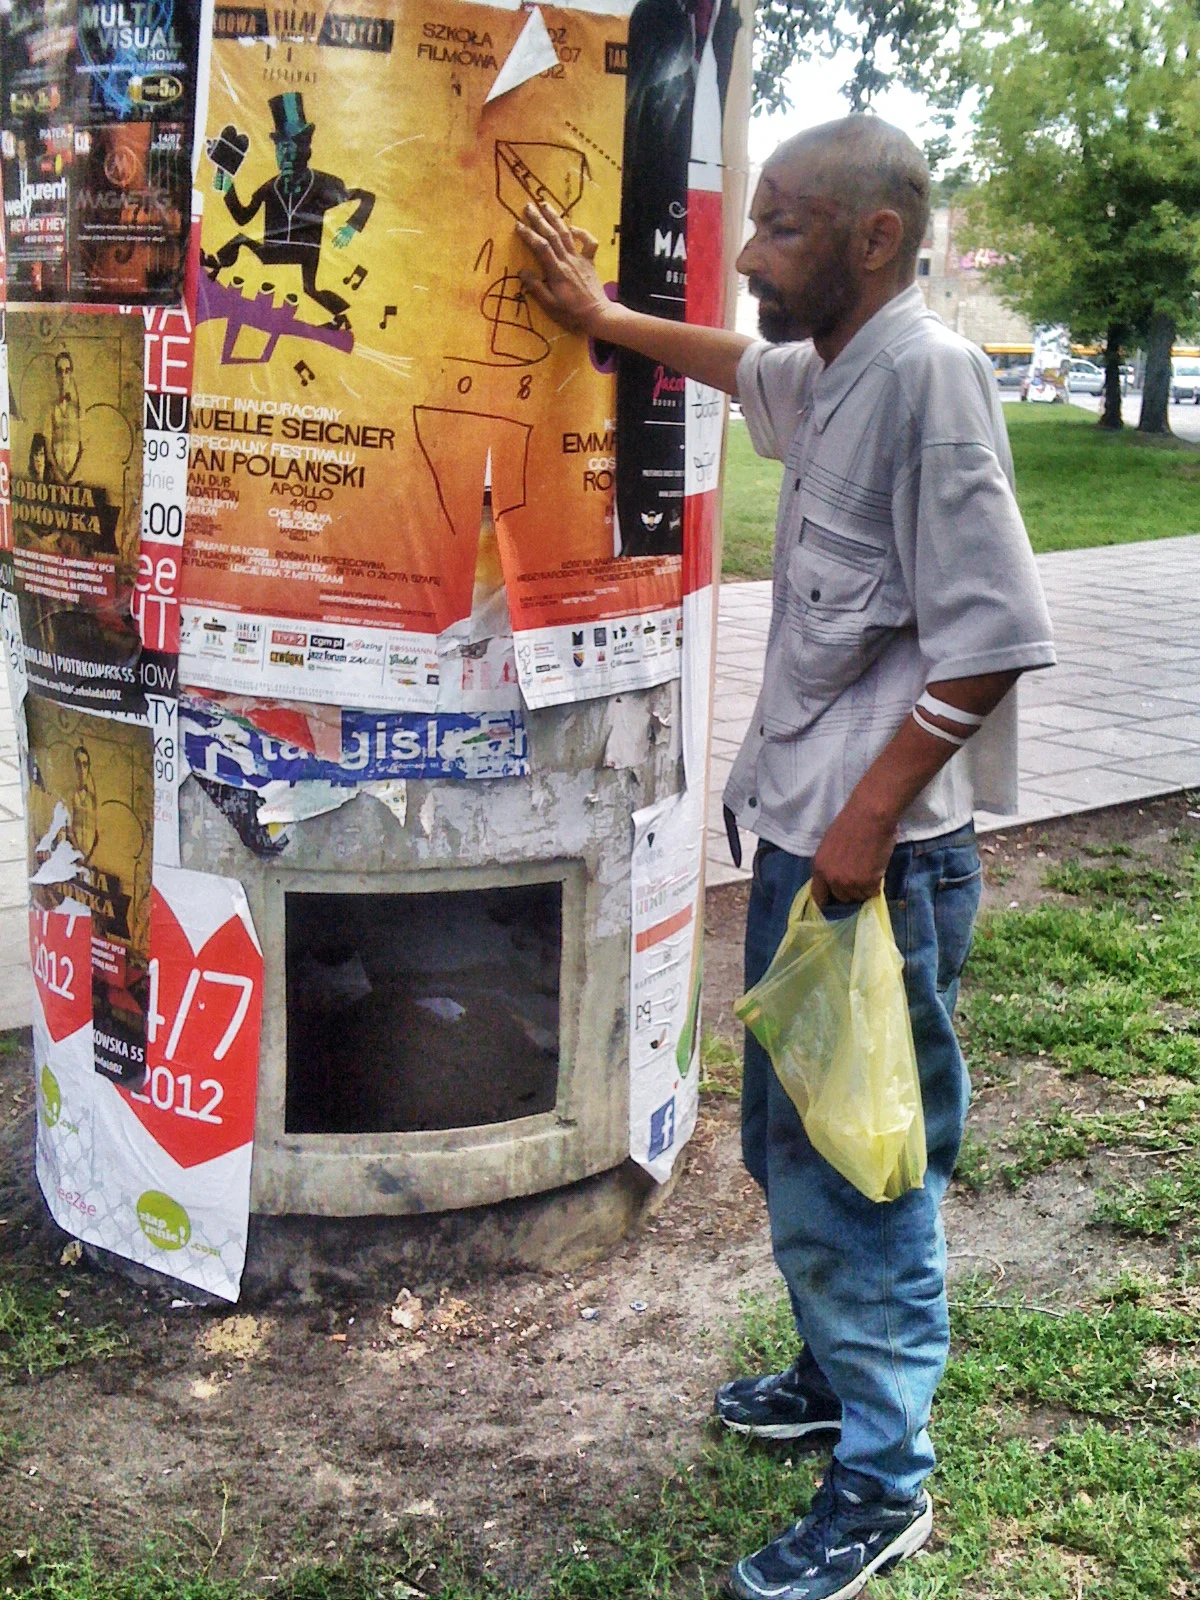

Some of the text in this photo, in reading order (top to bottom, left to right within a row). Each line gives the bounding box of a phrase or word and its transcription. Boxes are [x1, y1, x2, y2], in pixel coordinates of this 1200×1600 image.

[82, 3, 153, 28] MULTI
[99, 26, 182, 50] VISUAL
[28, 218, 44, 232] HEY
[46, 216, 66, 232] HEY
[281, 416, 396, 450] SEIGNER
[176, 435, 188, 459] 3
[270, 442, 357, 466] FESTIWALU
[270, 482, 334, 501] APOLLO
[155, 759, 175, 782] 90
